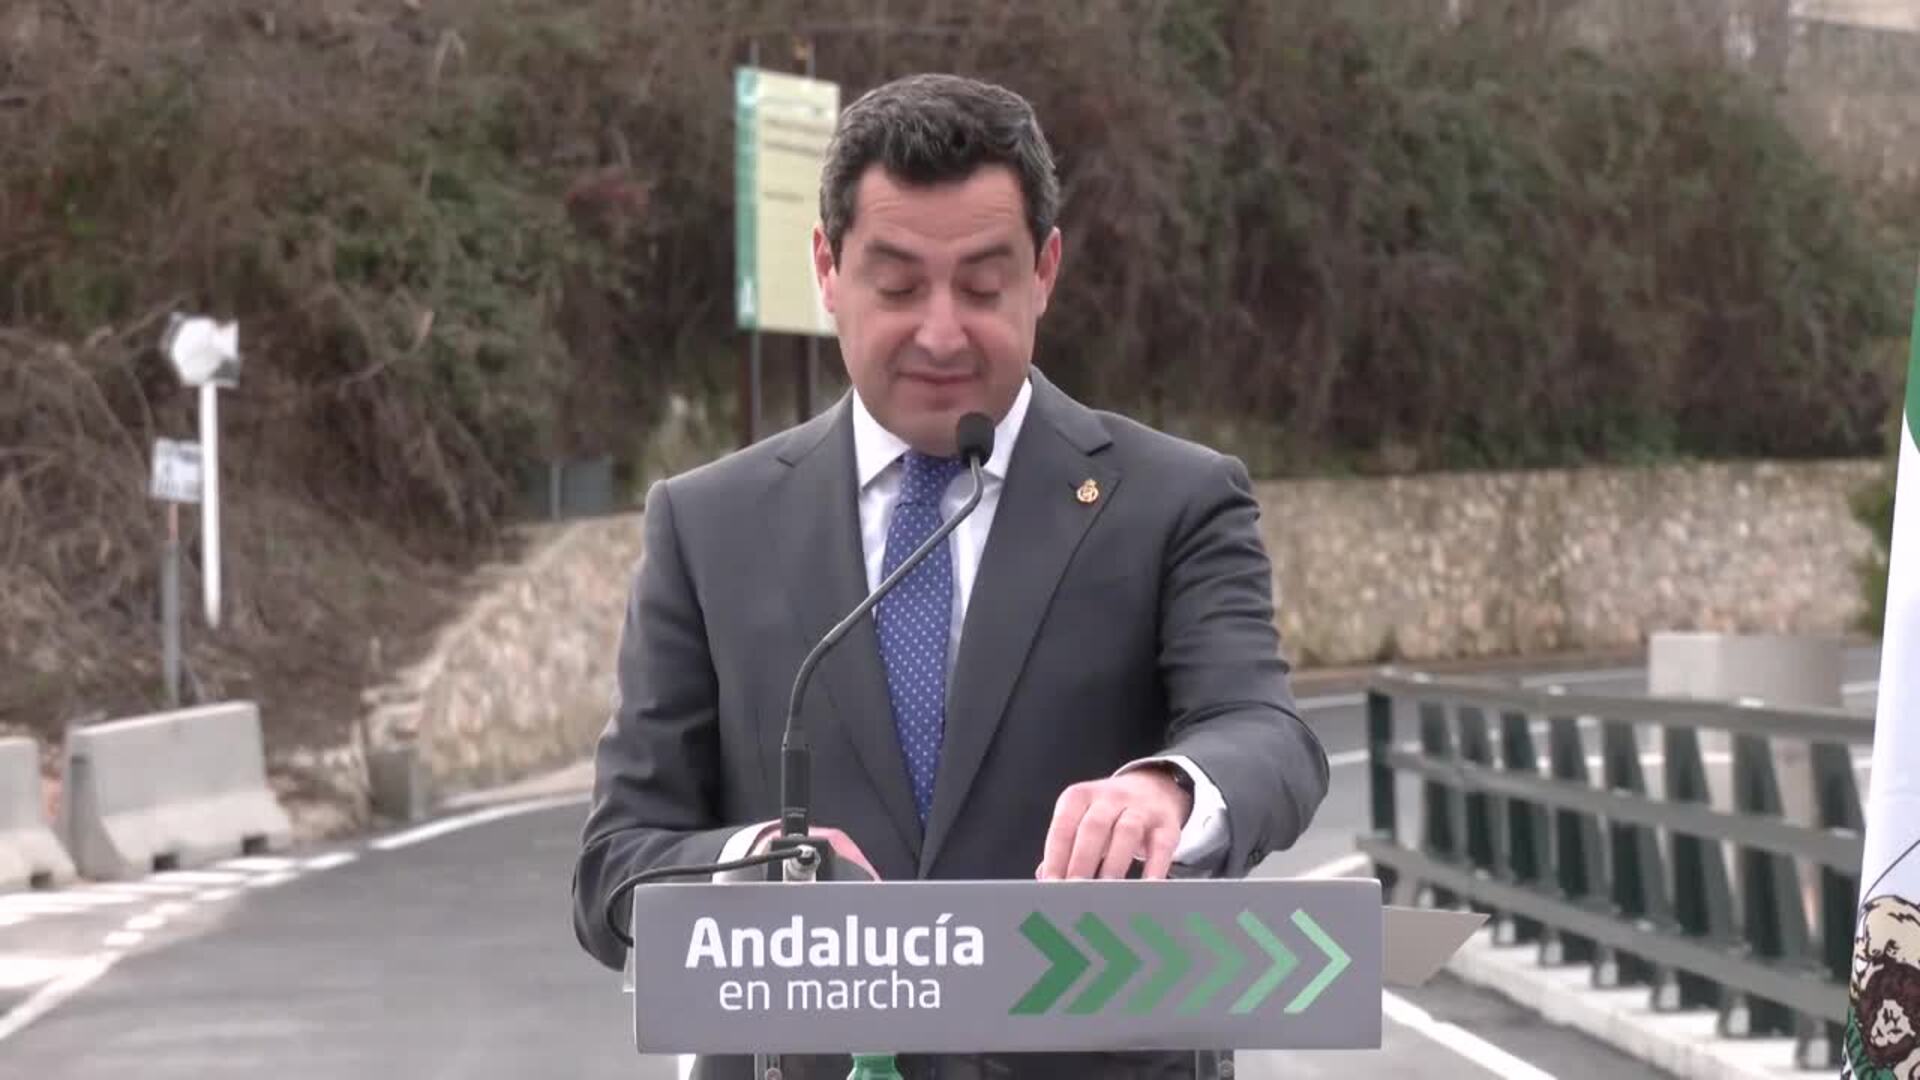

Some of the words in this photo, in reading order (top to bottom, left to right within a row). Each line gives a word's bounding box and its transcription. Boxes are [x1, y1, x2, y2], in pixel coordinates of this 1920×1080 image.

[685, 913, 985, 969] Andalucía
[719, 980, 771, 1011] en
[787, 969, 942, 1011] marcha
